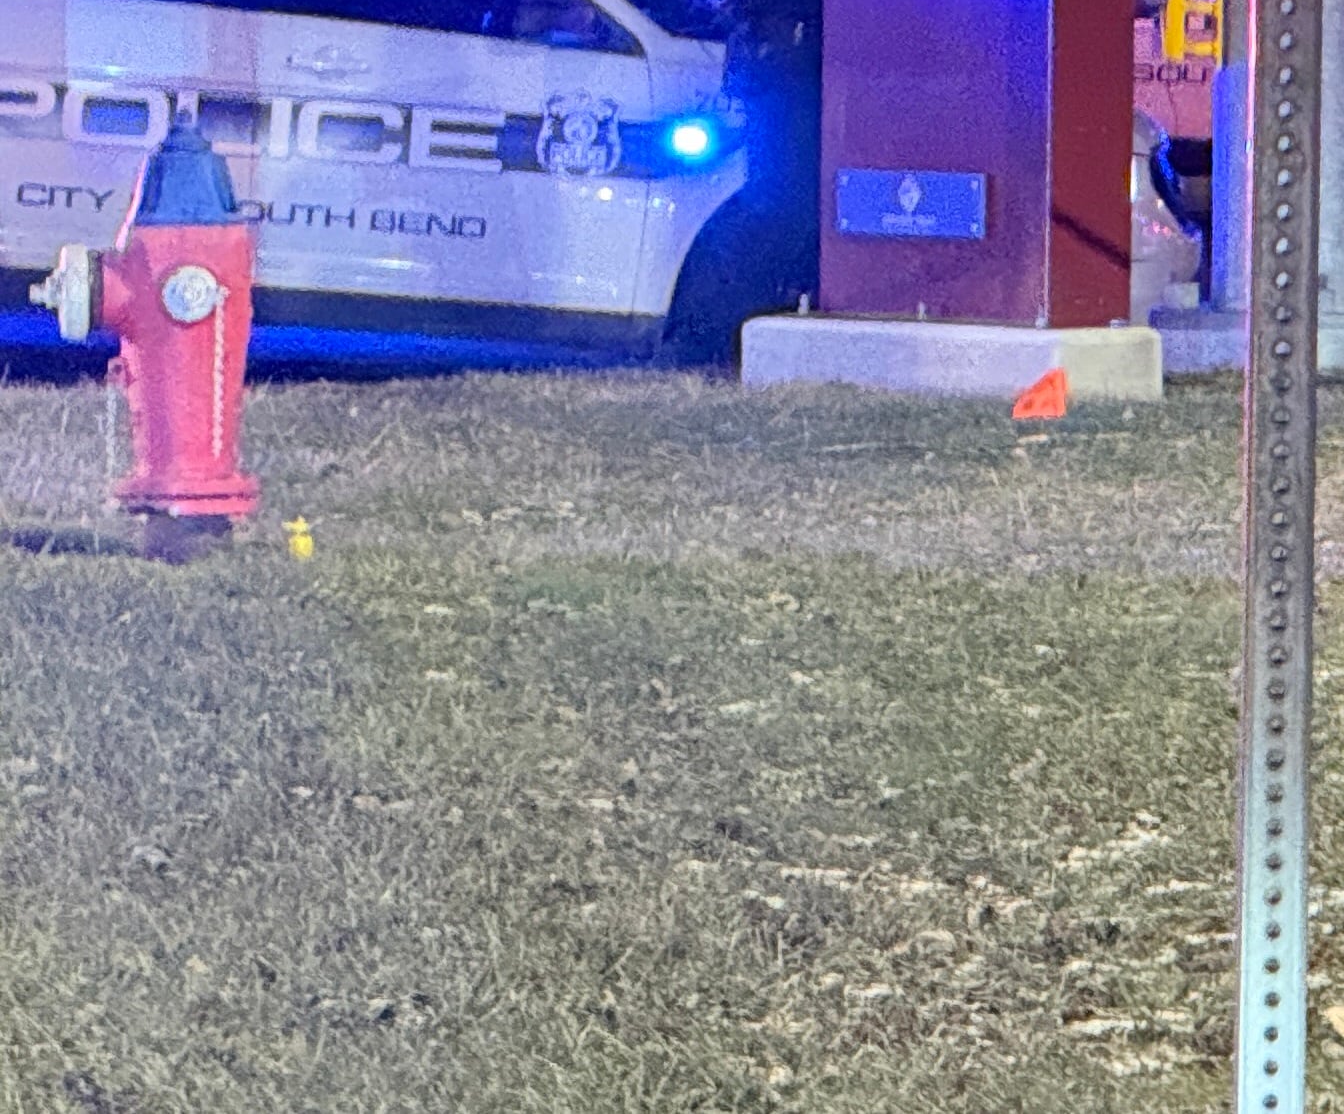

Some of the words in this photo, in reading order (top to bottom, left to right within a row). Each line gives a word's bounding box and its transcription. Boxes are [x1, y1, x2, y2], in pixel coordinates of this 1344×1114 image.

[17, 183, 115, 213] CITY
[231, 199, 356, 229] OUTH
[370, 208, 488, 239] BEND
